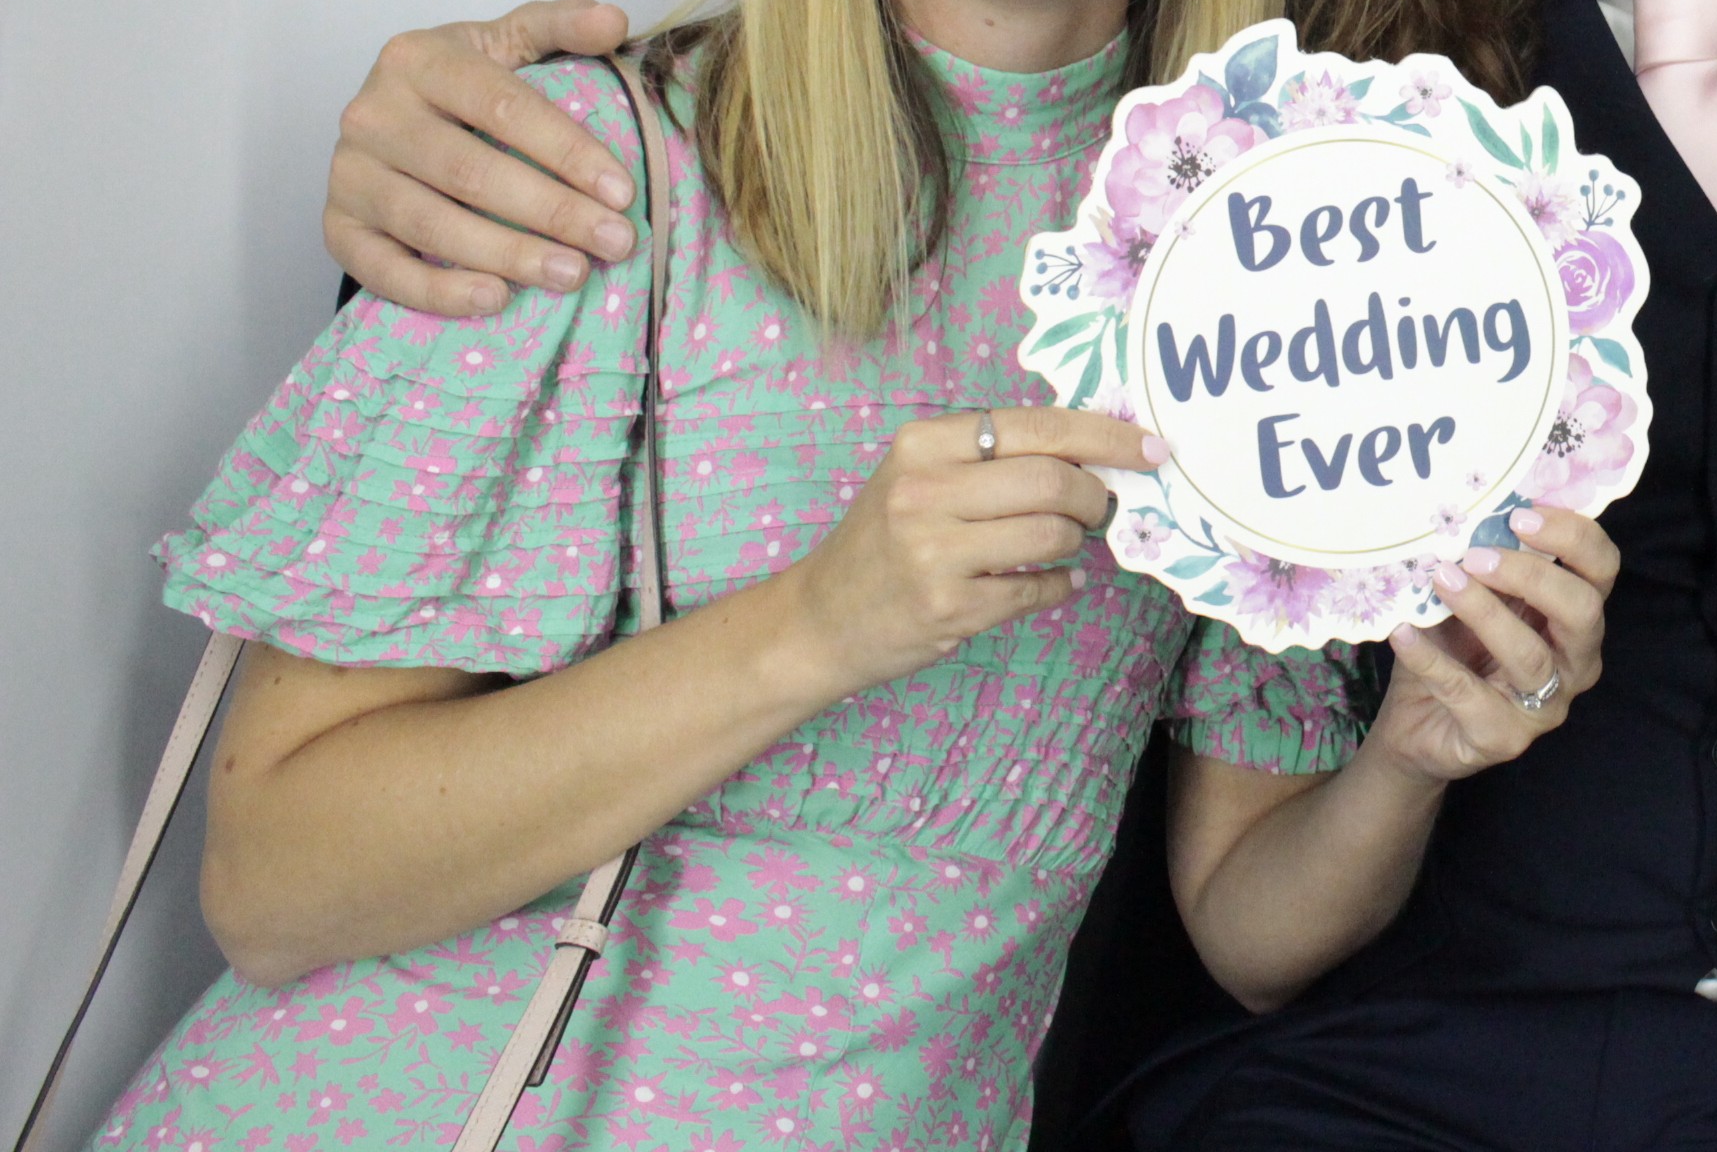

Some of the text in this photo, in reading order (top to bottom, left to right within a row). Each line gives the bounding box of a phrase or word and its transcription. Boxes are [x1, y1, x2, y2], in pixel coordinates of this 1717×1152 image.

[1227, 177, 1437, 272] Best
[1156, 291, 1531, 403] Wedding
[1257, 413, 1456, 499] Ever
